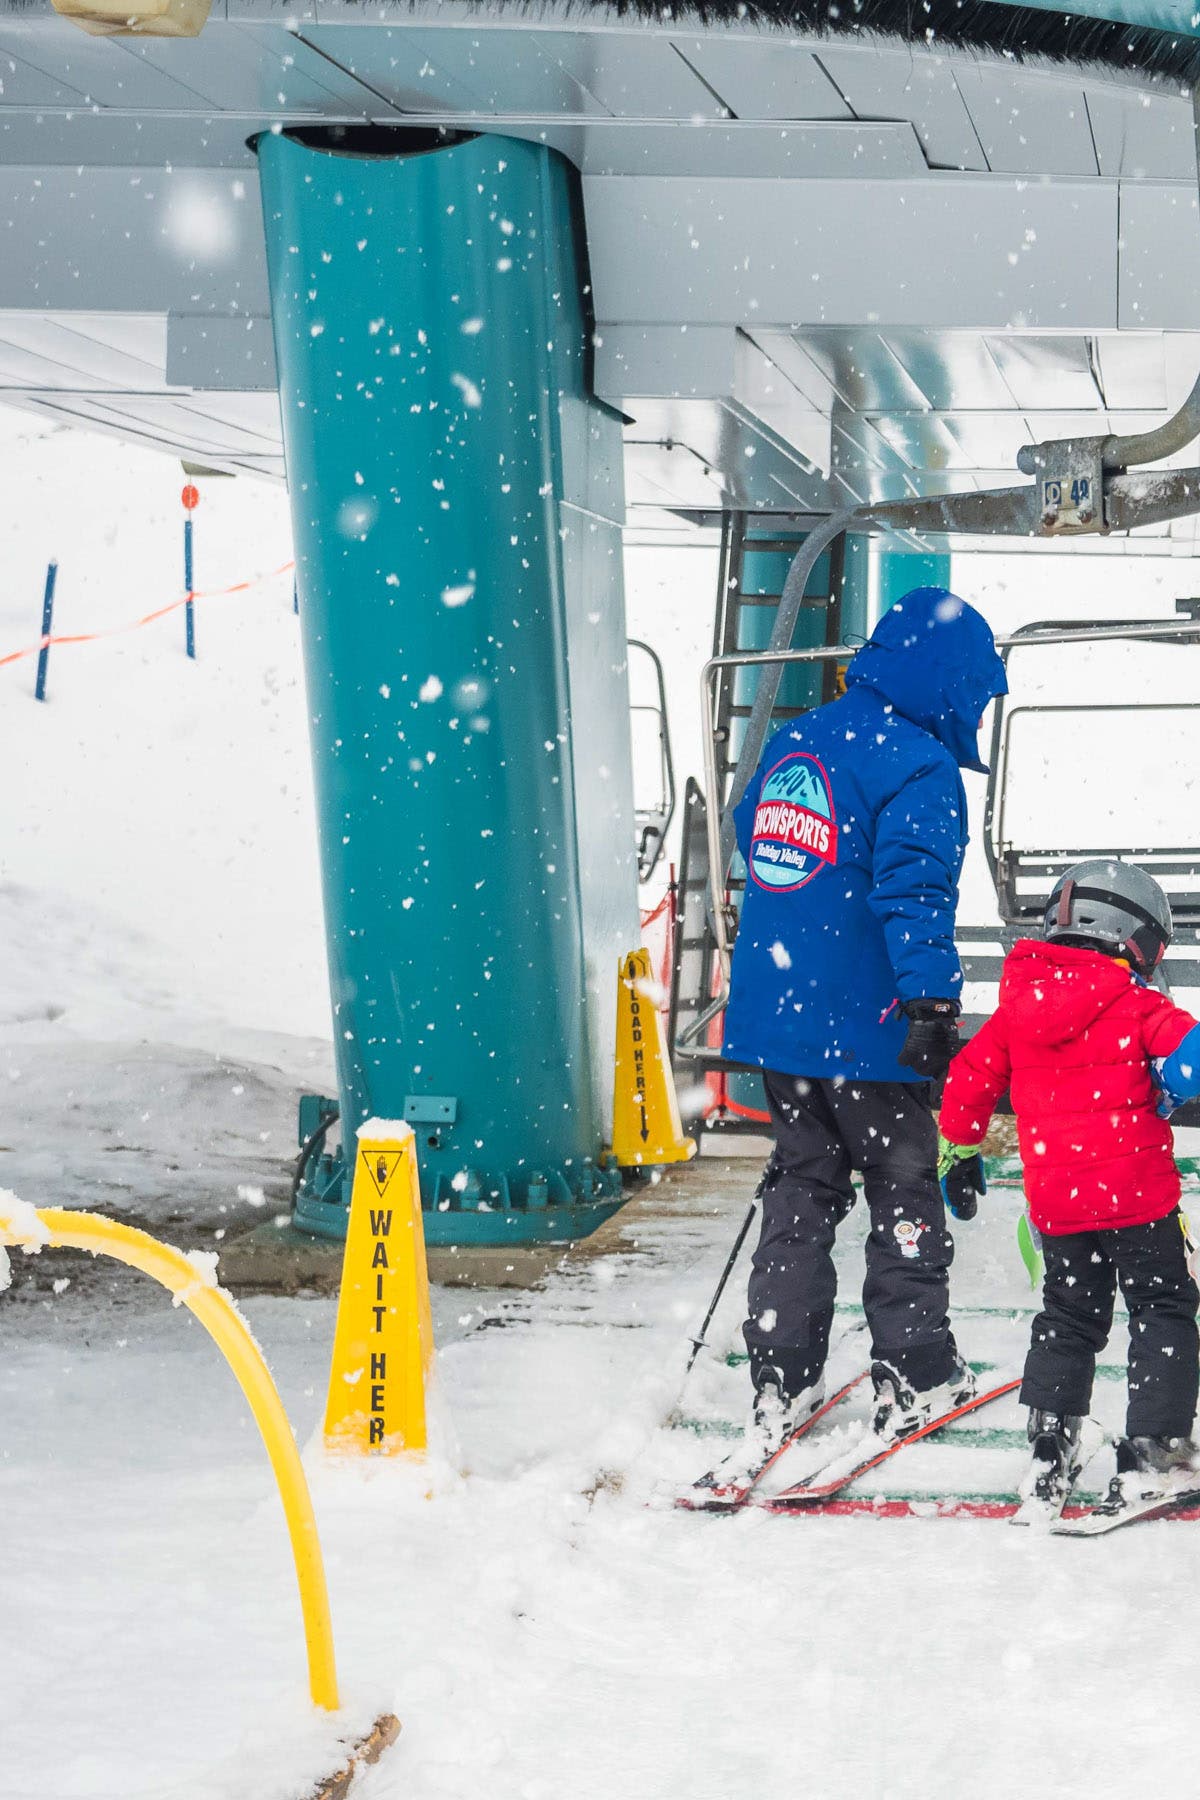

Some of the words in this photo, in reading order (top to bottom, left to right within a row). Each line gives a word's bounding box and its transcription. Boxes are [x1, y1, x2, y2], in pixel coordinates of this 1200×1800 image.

[779, 847, 807, 869] Valley
[630, 988, 642, 1042] LOAD
[369, 1209, 393, 1333] WAIT
[369, 1352, 387, 1456] HER
